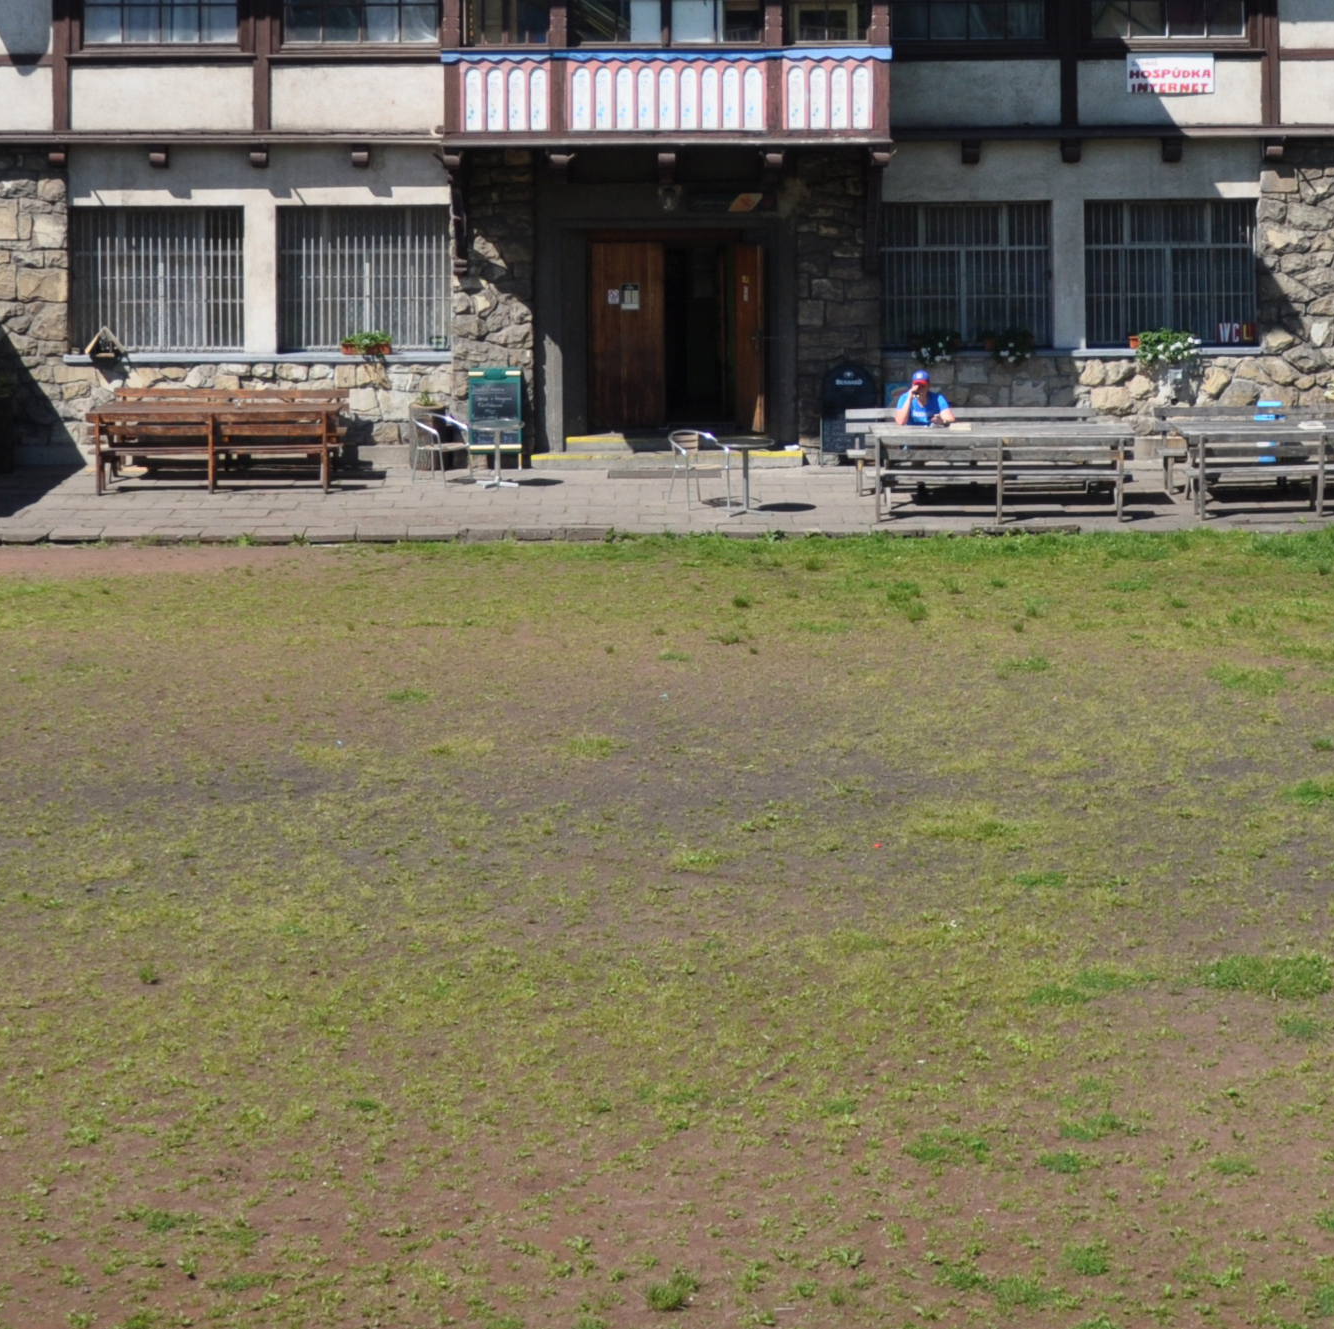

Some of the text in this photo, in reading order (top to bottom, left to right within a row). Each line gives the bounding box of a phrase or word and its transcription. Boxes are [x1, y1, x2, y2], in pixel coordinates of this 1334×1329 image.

[1129, 67, 1212, 79] HOSPŮDKA
[1131, 83, 1209, 94] INTERNET
[1219, 322, 1240, 343] WC
